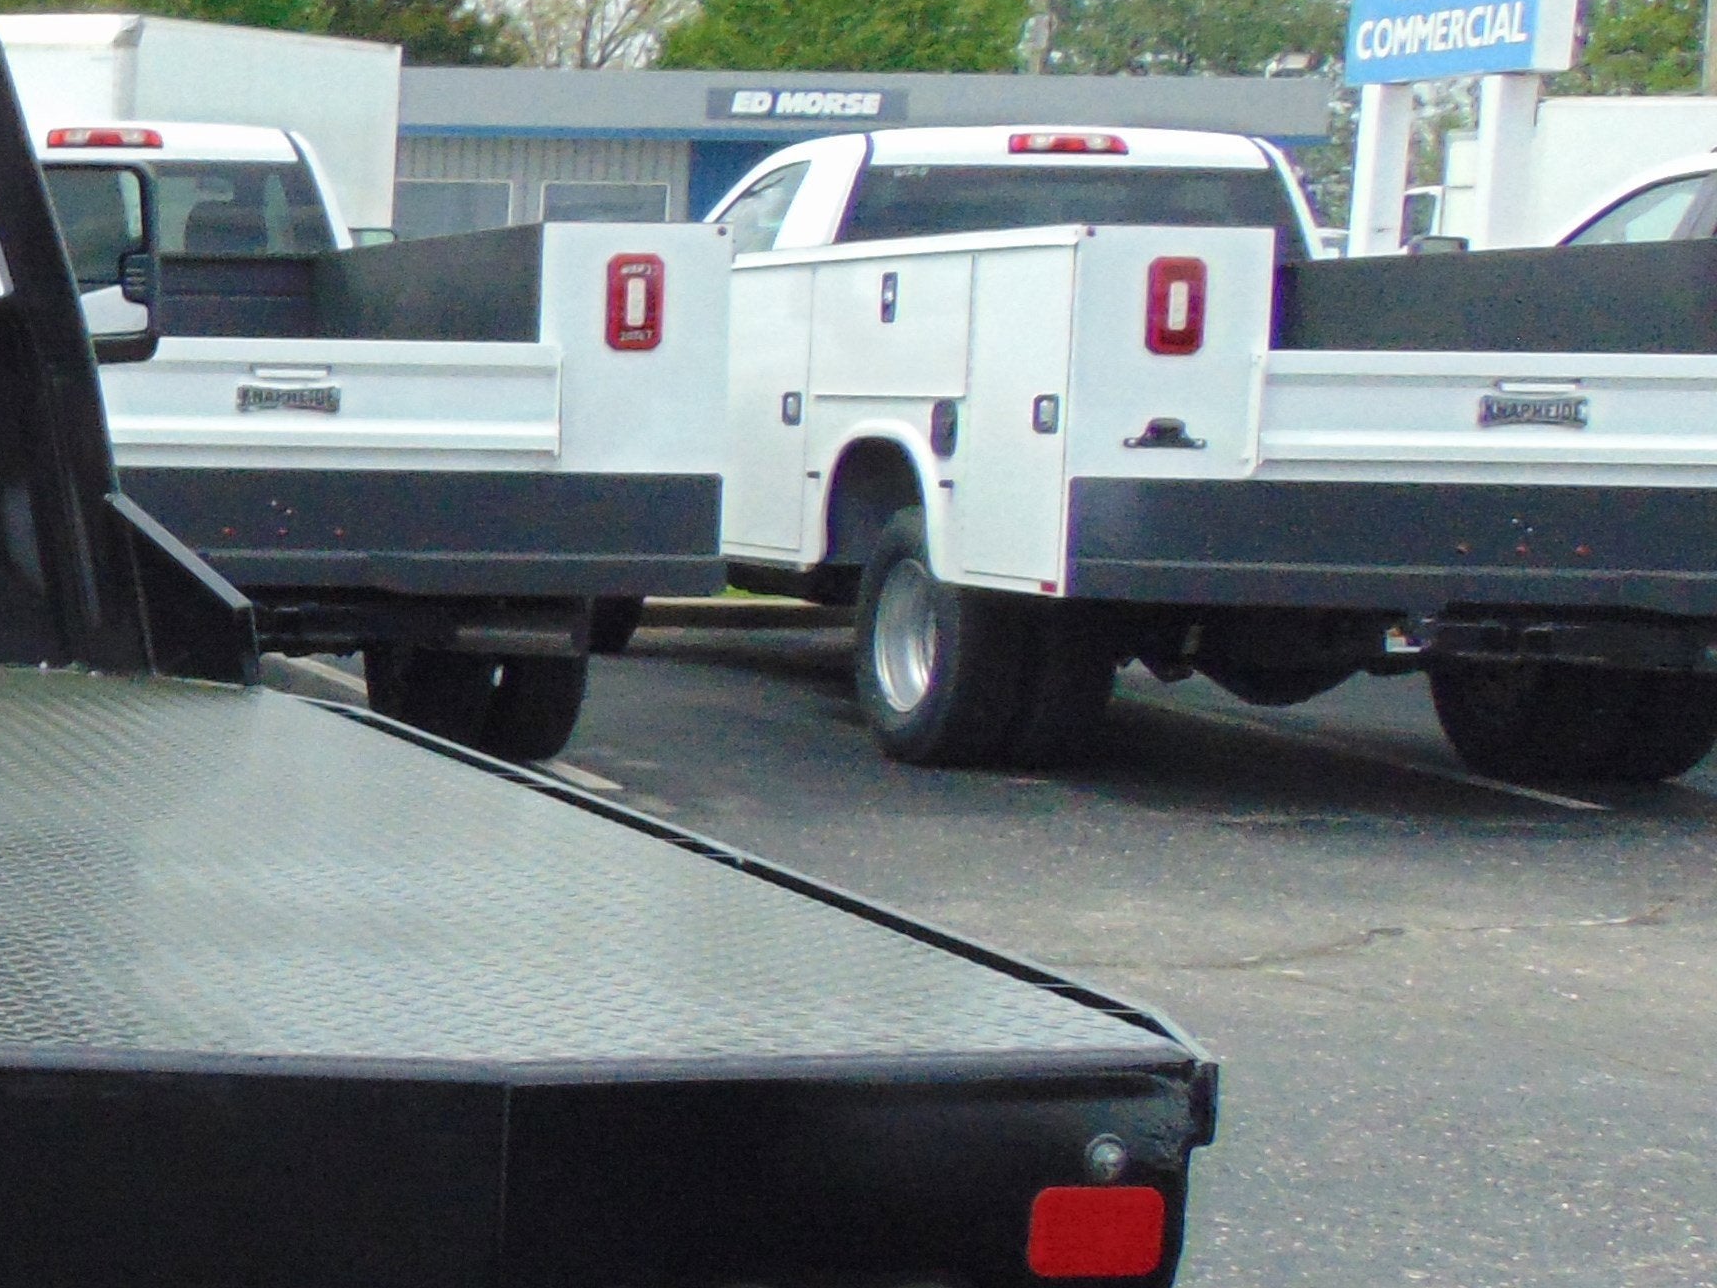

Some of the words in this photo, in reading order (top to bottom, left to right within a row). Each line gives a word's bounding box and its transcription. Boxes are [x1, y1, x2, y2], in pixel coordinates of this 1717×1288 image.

[1355, 1, 1528, 60] COMMERCIAL
[731, 90, 773, 114] ED
[775, 91, 883, 115] MORSE
